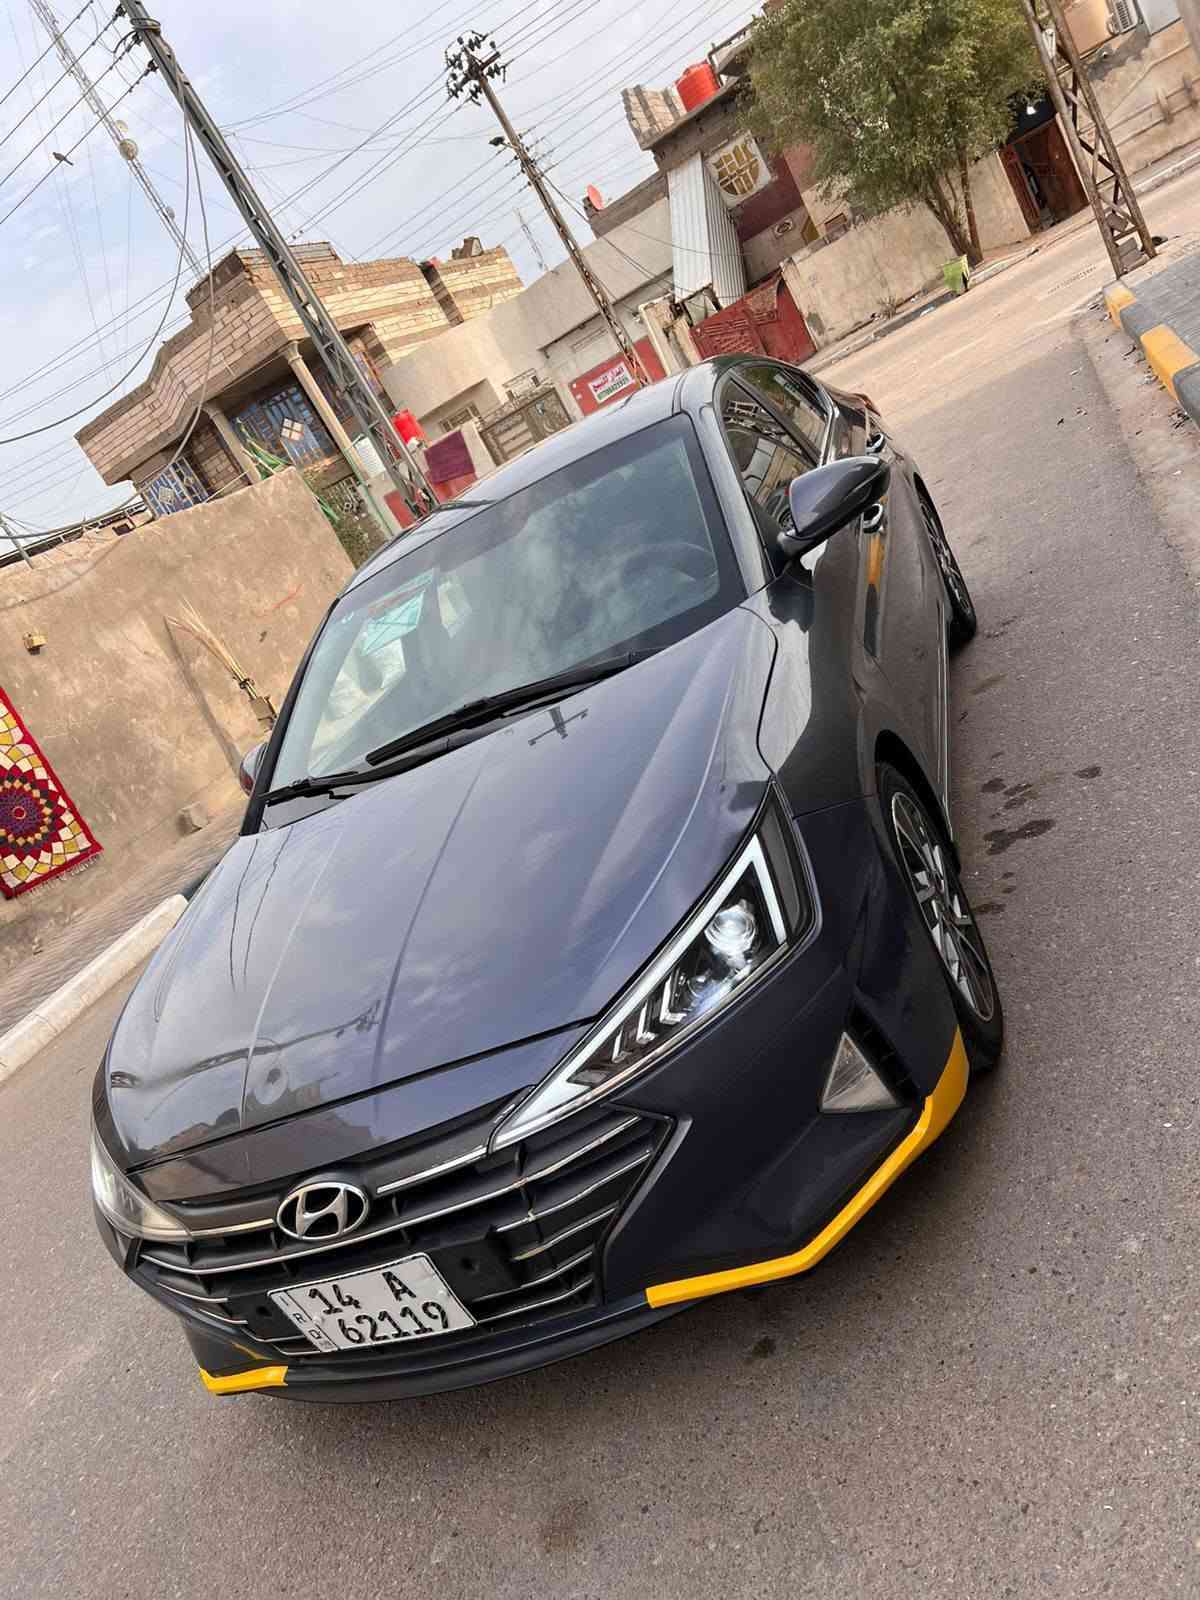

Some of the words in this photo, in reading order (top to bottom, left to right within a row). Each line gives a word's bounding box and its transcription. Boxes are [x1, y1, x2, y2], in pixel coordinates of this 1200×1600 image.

[308, 1284, 362, 1315] 14
[382, 1271, 416, 1301] A
[338, 1301, 449, 1344] 62119
